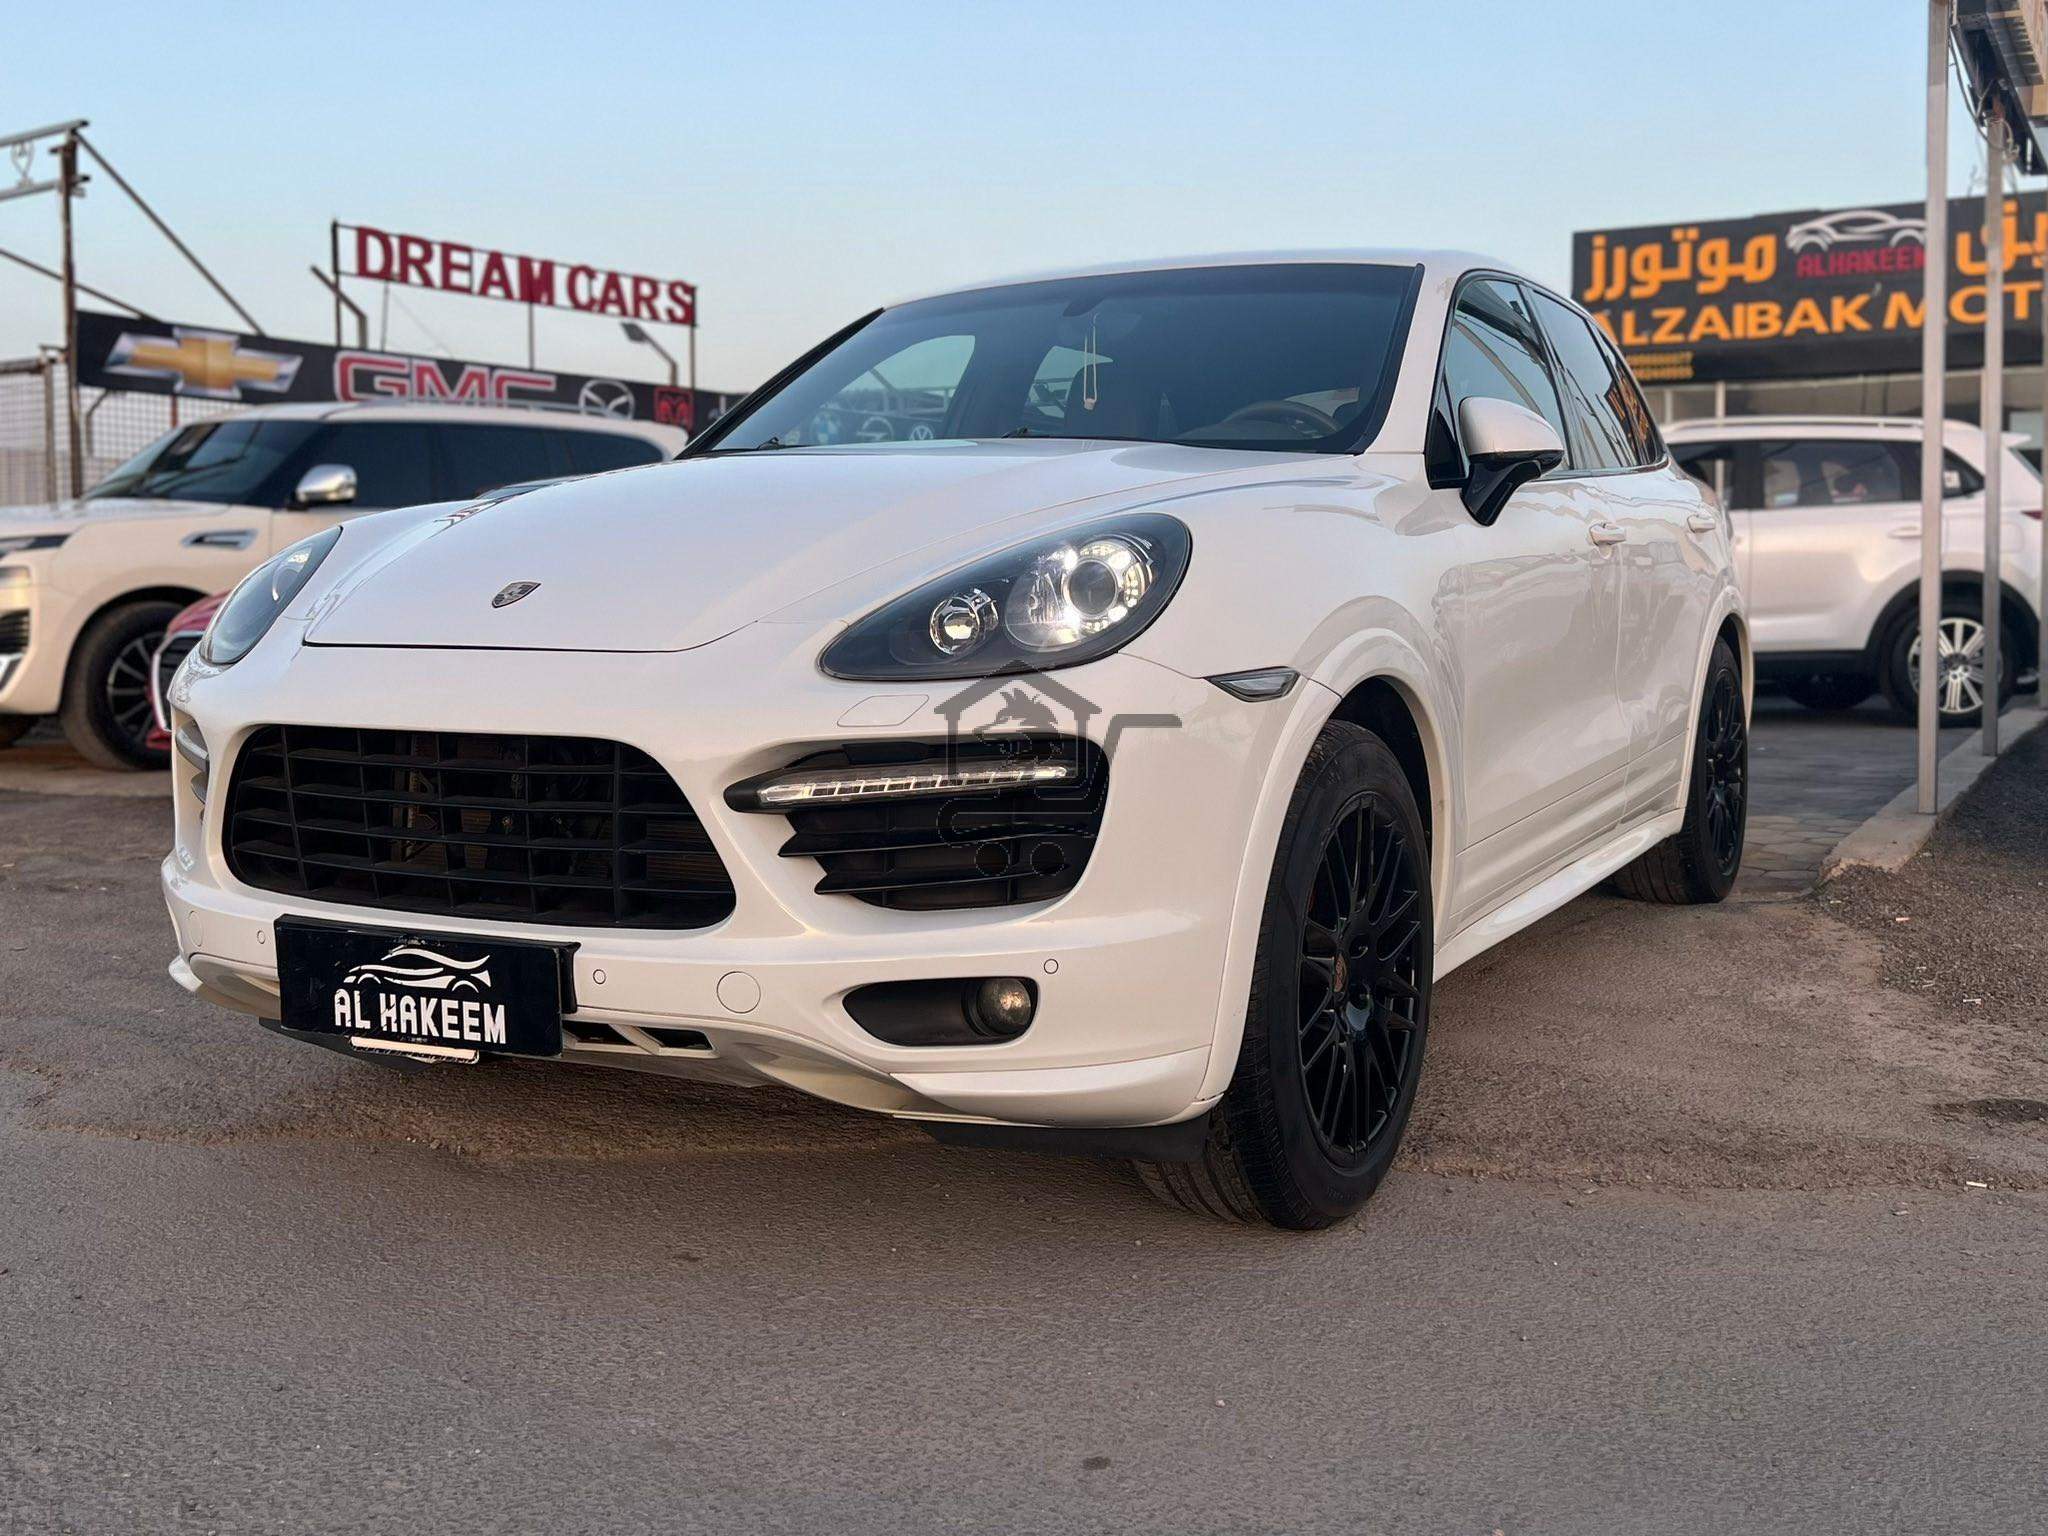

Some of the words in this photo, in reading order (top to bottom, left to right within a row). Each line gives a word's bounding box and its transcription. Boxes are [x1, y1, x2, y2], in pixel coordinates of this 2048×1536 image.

[357, 226, 556, 306] DREAM
[567, 265, 696, 325] CARS
[1582, 225, 1778, 303] موتورز
[334, 350, 557, 407] GMC
[334, 988, 370, 1029] AL
[379, 992, 507, 1045] HAKEEM
